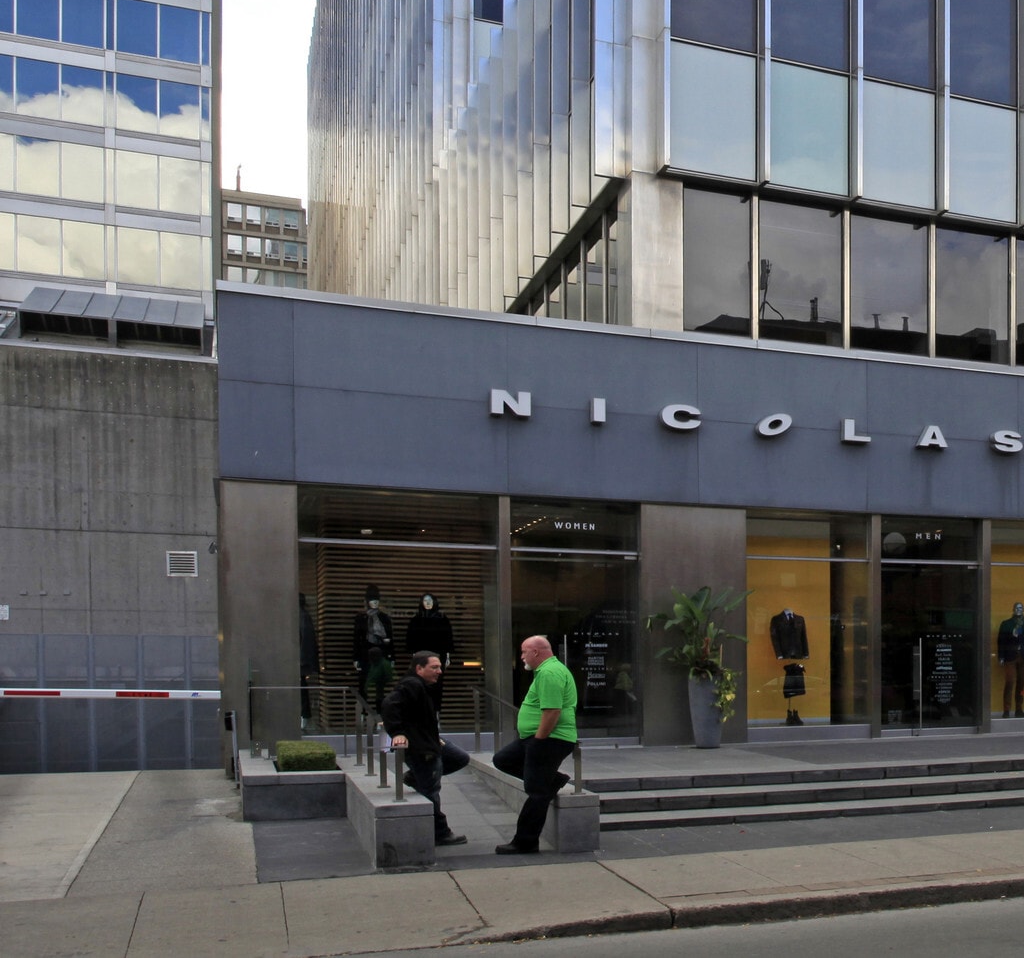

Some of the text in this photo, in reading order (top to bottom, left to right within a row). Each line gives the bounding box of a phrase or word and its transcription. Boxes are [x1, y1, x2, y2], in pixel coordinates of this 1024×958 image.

[489, 388, 1024, 453] NICOLAS
[554, 522, 596, 531] WOMEN
[915, 532, 942, 540] MEN
